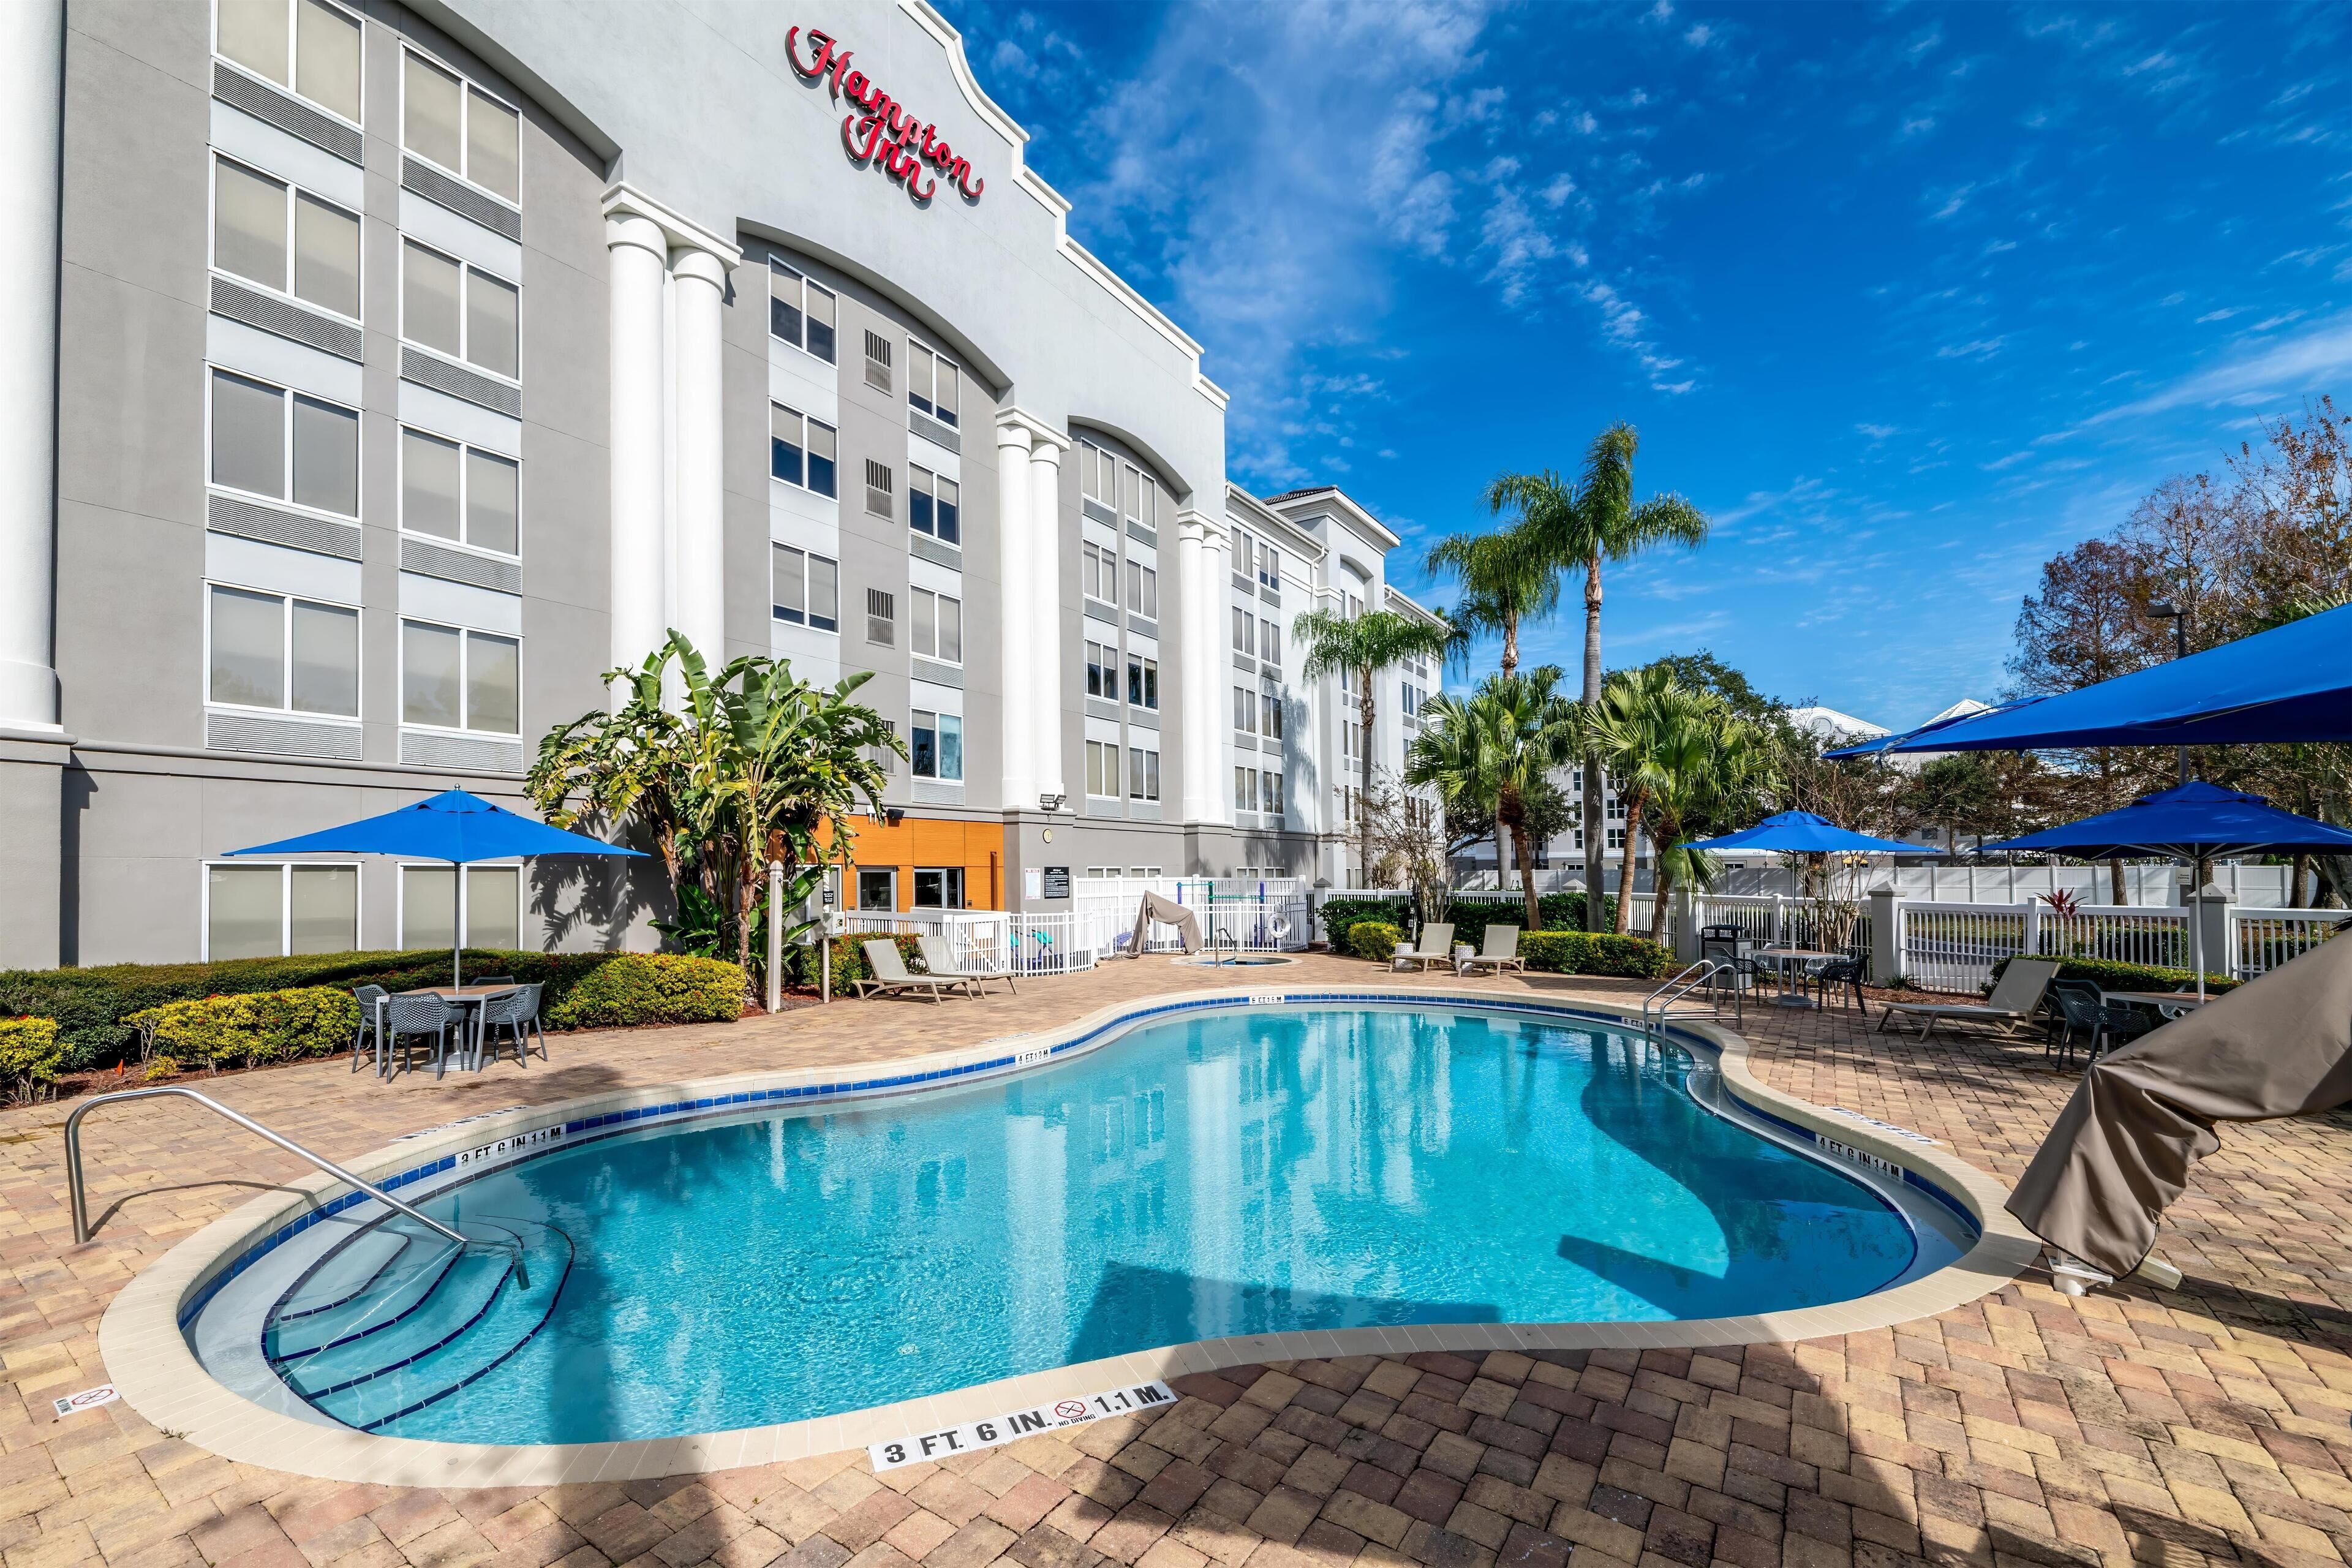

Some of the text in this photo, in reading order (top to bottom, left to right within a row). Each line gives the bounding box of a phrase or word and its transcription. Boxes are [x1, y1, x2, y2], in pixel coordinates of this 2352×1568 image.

[785, 26, 984, 198] Hampton
[841, 115, 936, 199] Inn
[884, 1385, 1170, 1463] 3 FT. 6 IN. 1.1 M.
[1071, 1414, 1096, 1424] DIVING
